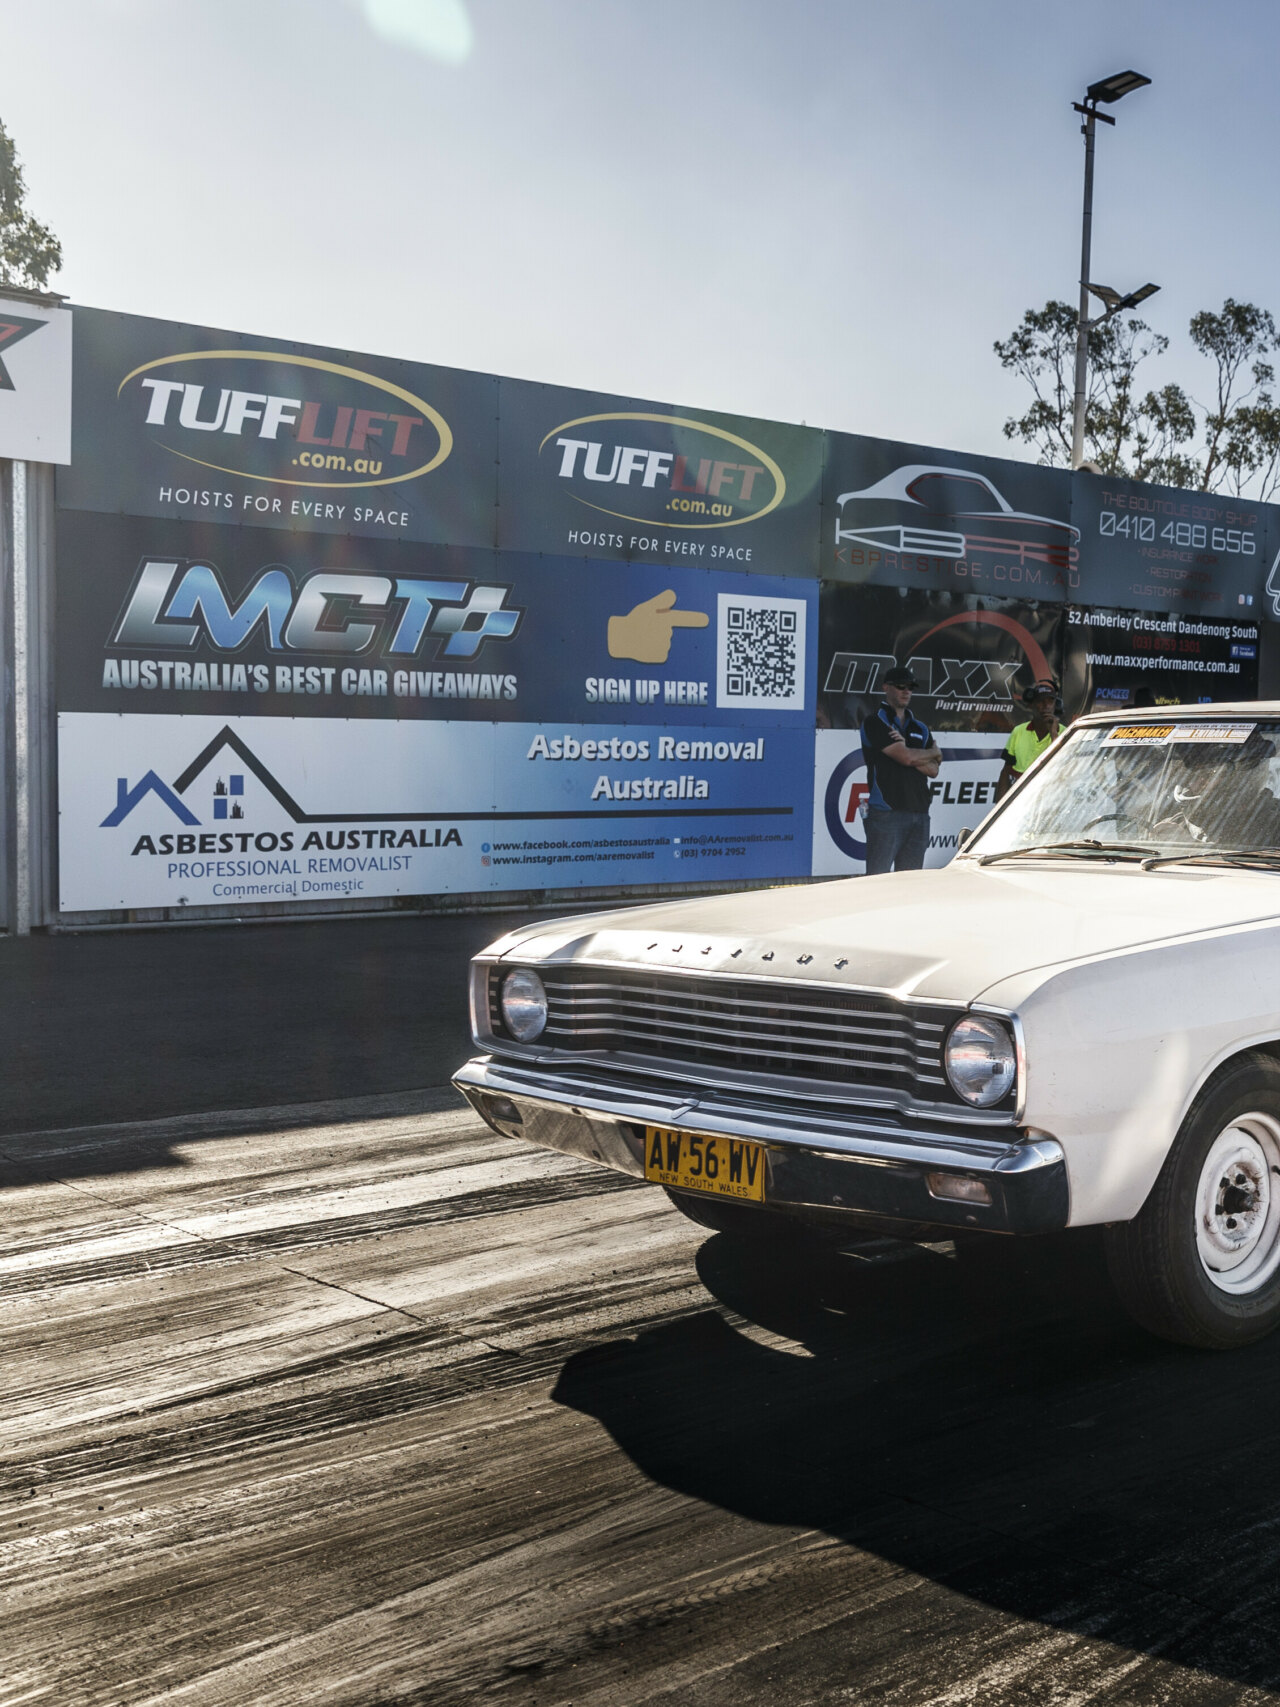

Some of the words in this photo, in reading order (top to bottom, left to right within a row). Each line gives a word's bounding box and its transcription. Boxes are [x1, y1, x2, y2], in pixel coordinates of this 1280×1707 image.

[141, 378, 424, 456] TUFFLIFT
[292, 451, 383, 475] .com.au
[556, 438, 764, 500] TUFFLIFT
[159, 487, 233, 508] HOISTS
[244, 495, 281, 513] FOR
[291, 500, 346, 520] EVERY
[353, 507, 409, 527] SPACE
[665, 498, 732, 517] .com.au
[1102, 491, 1127, 504] THE
[568, 530, 623, 548] HOISTS
[630, 537, 658, 551] FOR
[665, 540, 705, 556] EVERY
[711, 545, 752, 561] SPACE
[1100, 511, 1155, 542] 0410
[1160, 521, 1206, 548] 488
[1212, 527, 1256, 555] 656
[1068, 611, 1081, 625] 52
[1083, 612, 1132, 632] Amberley
[1133, 617, 1177, 633] Crescent
[1178, 621, 1230, 639] Dandenong
[1232, 625, 1258, 639] South
[1085, 653, 1240, 674] www.maxxperformance.com.au
[102, 659, 269, 692] AUSTRALIA'S
[276, 666, 336, 694] BEST
[341, 668, 388, 696] CAR
[394, 670, 517, 700] GIVEAWAYS
[585, 677, 631, 704] SIGN
[635, 679, 660, 705] UP
[664, 681, 708, 706] HERE
[935, 699, 1013, 713] Performance
[527, 734, 650, 761] Asbestos
[658, 736, 765, 761] Removal
[591, 775, 710, 801] Australia
[131, 831, 294, 856] ASBESTOS
[301, 828, 463, 851] AUSTRALIA
[493, 836, 671, 851] www.facebook.com/asbestosaustralia
[681, 848, 698, 859] (03)
[167, 858, 301, 879] PROFESSIONAL
[308, 855, 413, 874] REMOVALIST
[493, 850, 655, 866] www.instagram.com/aaremovalist
[212, 880, 297, 897] Commercial
[301, 878, 364, 894] Domestic
[659, 1172, 678, 1183] NEW
[684, 1176, 714, 1190] SOUTH
[718, 1184, 748, 1197] WALES
